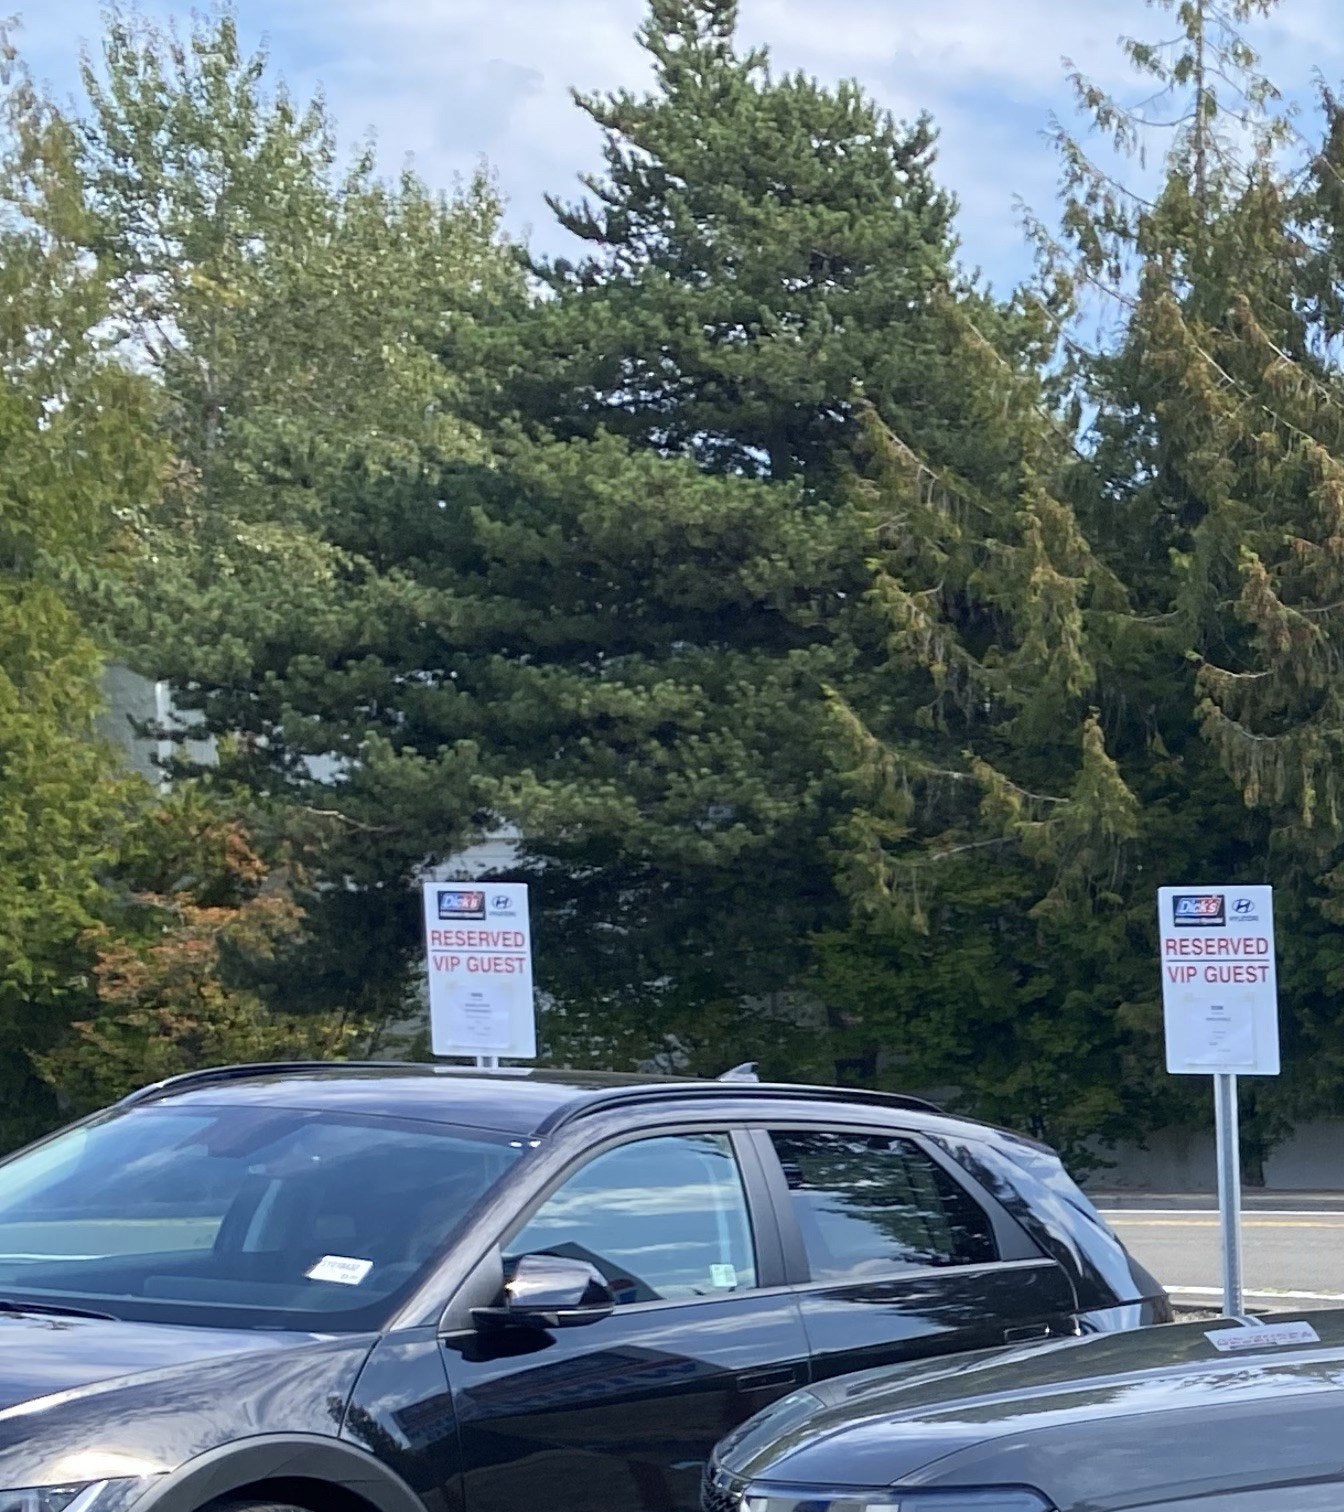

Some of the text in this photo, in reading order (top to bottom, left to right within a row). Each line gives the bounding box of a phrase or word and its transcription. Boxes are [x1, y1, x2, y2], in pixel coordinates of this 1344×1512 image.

[431, 930, 525, 947] RESERVED
[1165, 937, 1269, 956] RESERVED
[433, 956, 526, 974] VIP GUEST
[1168, 965, 1269, 984] VIP GUEST
